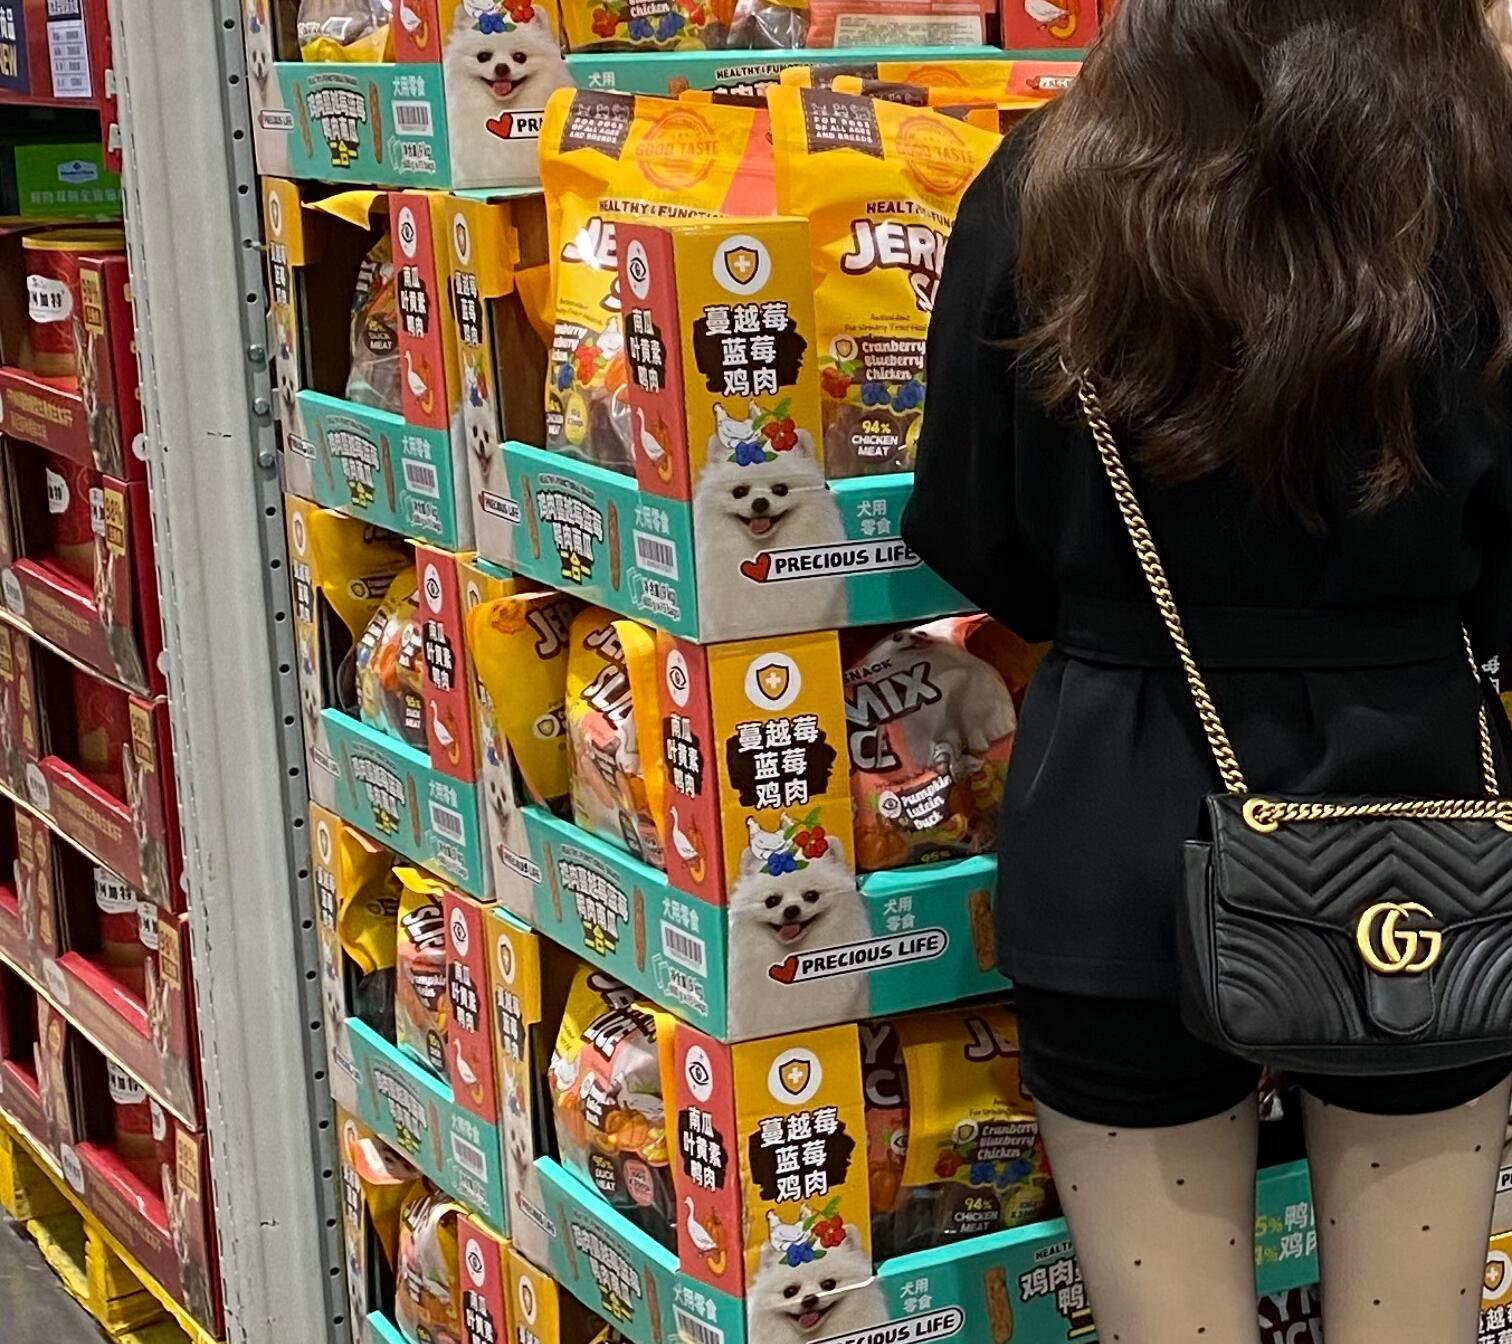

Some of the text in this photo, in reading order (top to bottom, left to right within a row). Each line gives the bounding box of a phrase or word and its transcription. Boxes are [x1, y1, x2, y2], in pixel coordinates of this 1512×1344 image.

[704, 304, 788, 338] 蔓越莓
[721, 337, 777, 366] 蓝莓
[862, 341, 926, 355] Cranberry
[864, 355, 924, 368] Blueberry
[723, 367, 779, 397] 鸡肉
[866, 368, 912, 381] Chicken
[852, 435, 898, 446] CHICKEN
[862, 420, 891, 434] 94%
[858, 446, 889, 457] MEAT
[857, 500, 887, 518] 犬用
[861, 517, 891, 535] 零食
[775, 541, 917, 574] PRECIOUS LIFE
[737, 717, 819, 754] 蔓越莓
[754, 748, 807, 780] 蓝莓
[755, 778, 808, 810] 鸡肉
[802, 932, 939, 975] PRECIOUS LIFE
[760, 1107, 839, 1147] 蔓越莓
[774, 1143, 827, 1174] 蓝莓
[776, 1171, 830, 1203] 鸡肉
[916, 1313, 956, 1338] LIFE
